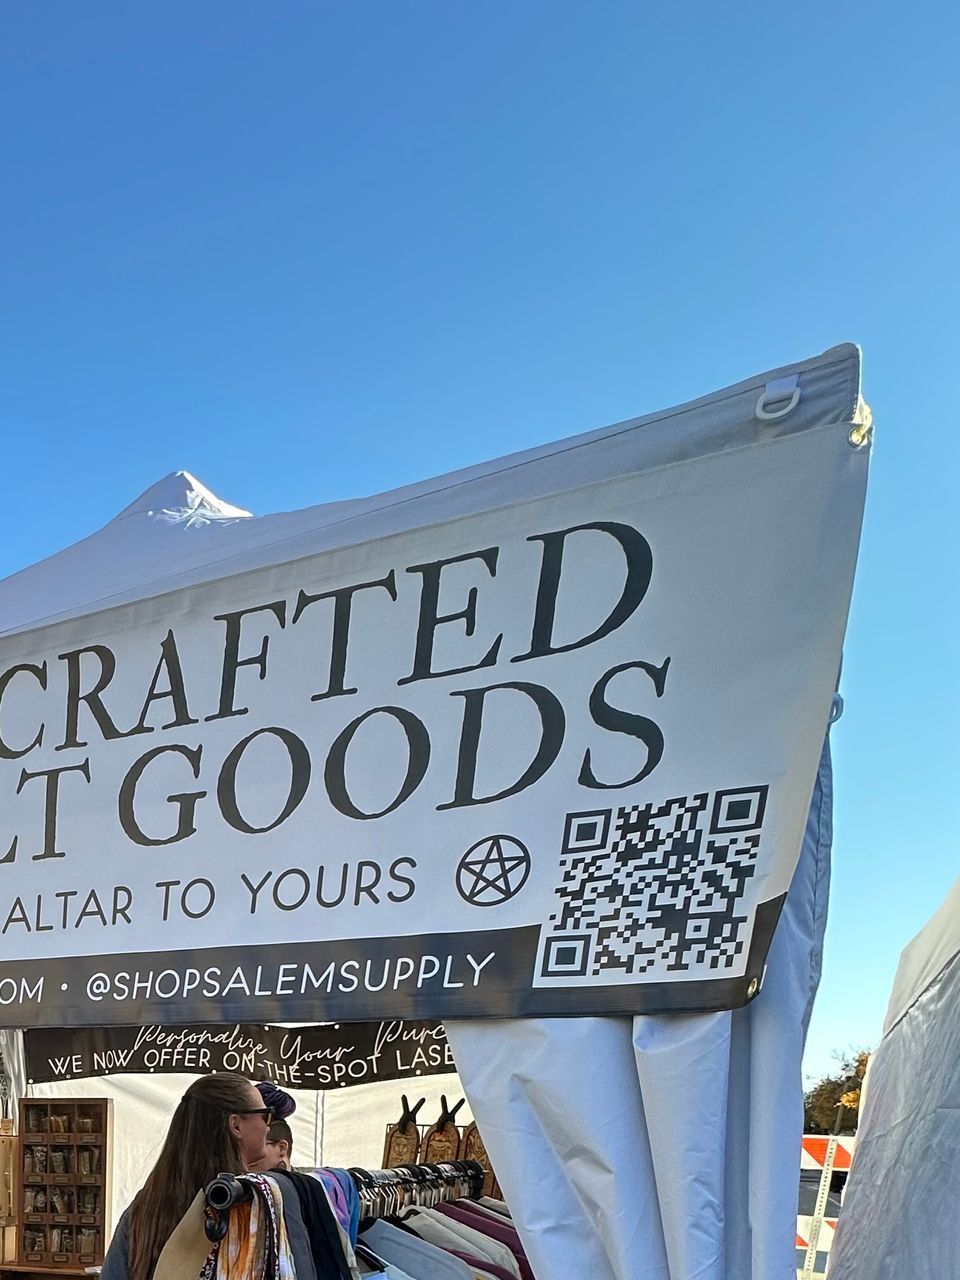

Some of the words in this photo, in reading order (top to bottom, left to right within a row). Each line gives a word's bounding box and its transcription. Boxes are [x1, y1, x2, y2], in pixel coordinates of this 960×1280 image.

[118, 656, 672, 847] GOODS
[1, 886, 133, 936] ALTAR
[155, 877, 216, 922] TO
[240, 856, 418, 915] YOURS
[86, 951, 496, 1002] @SHOPSALEMSUPPLY
[48, 1053, 83, 1075] WE
[93, 1048, 135, 1070] NOW
[143, 1047, 211, 1068] OFFER
[222, 1049, 382, 1084] ON-THE-SPOT
[133, 1024, 268, 1060] Personalize
[279, 1034, 355, 1072] Your
